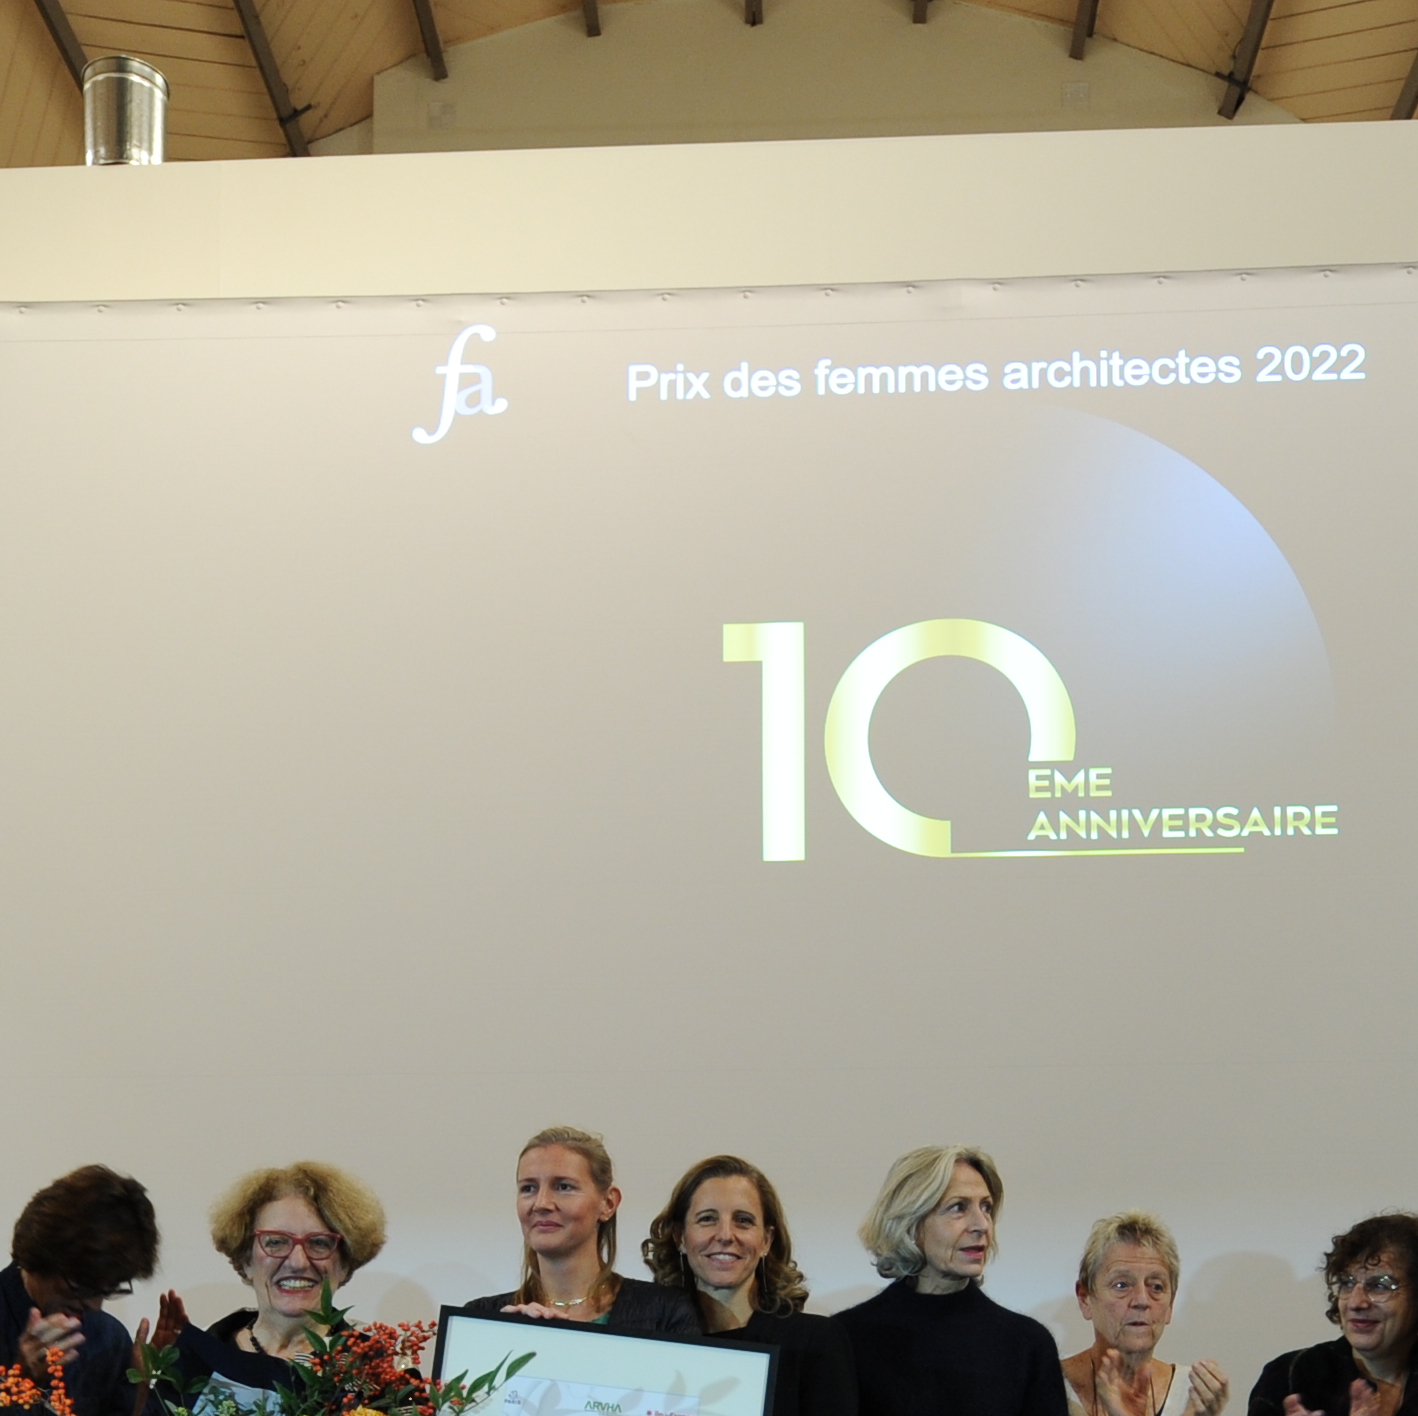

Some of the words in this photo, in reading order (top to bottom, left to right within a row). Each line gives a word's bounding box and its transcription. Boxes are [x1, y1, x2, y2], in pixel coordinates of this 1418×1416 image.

[628, 363, 710, 402] Prix
[724, 358, 801, 398] des
[814, 354, 988, 396] femmes
[1003, 346, 1242, 391] architectes
[1255, 343, 1366, 384] 2022
[723, 618, 1076, 859] 10
[1029, 767, 1112, 798] EME
[1027, 805, 1338, 840] ANNIVERSAIRE
[585, 1401, 622, 1413] ARVHA
